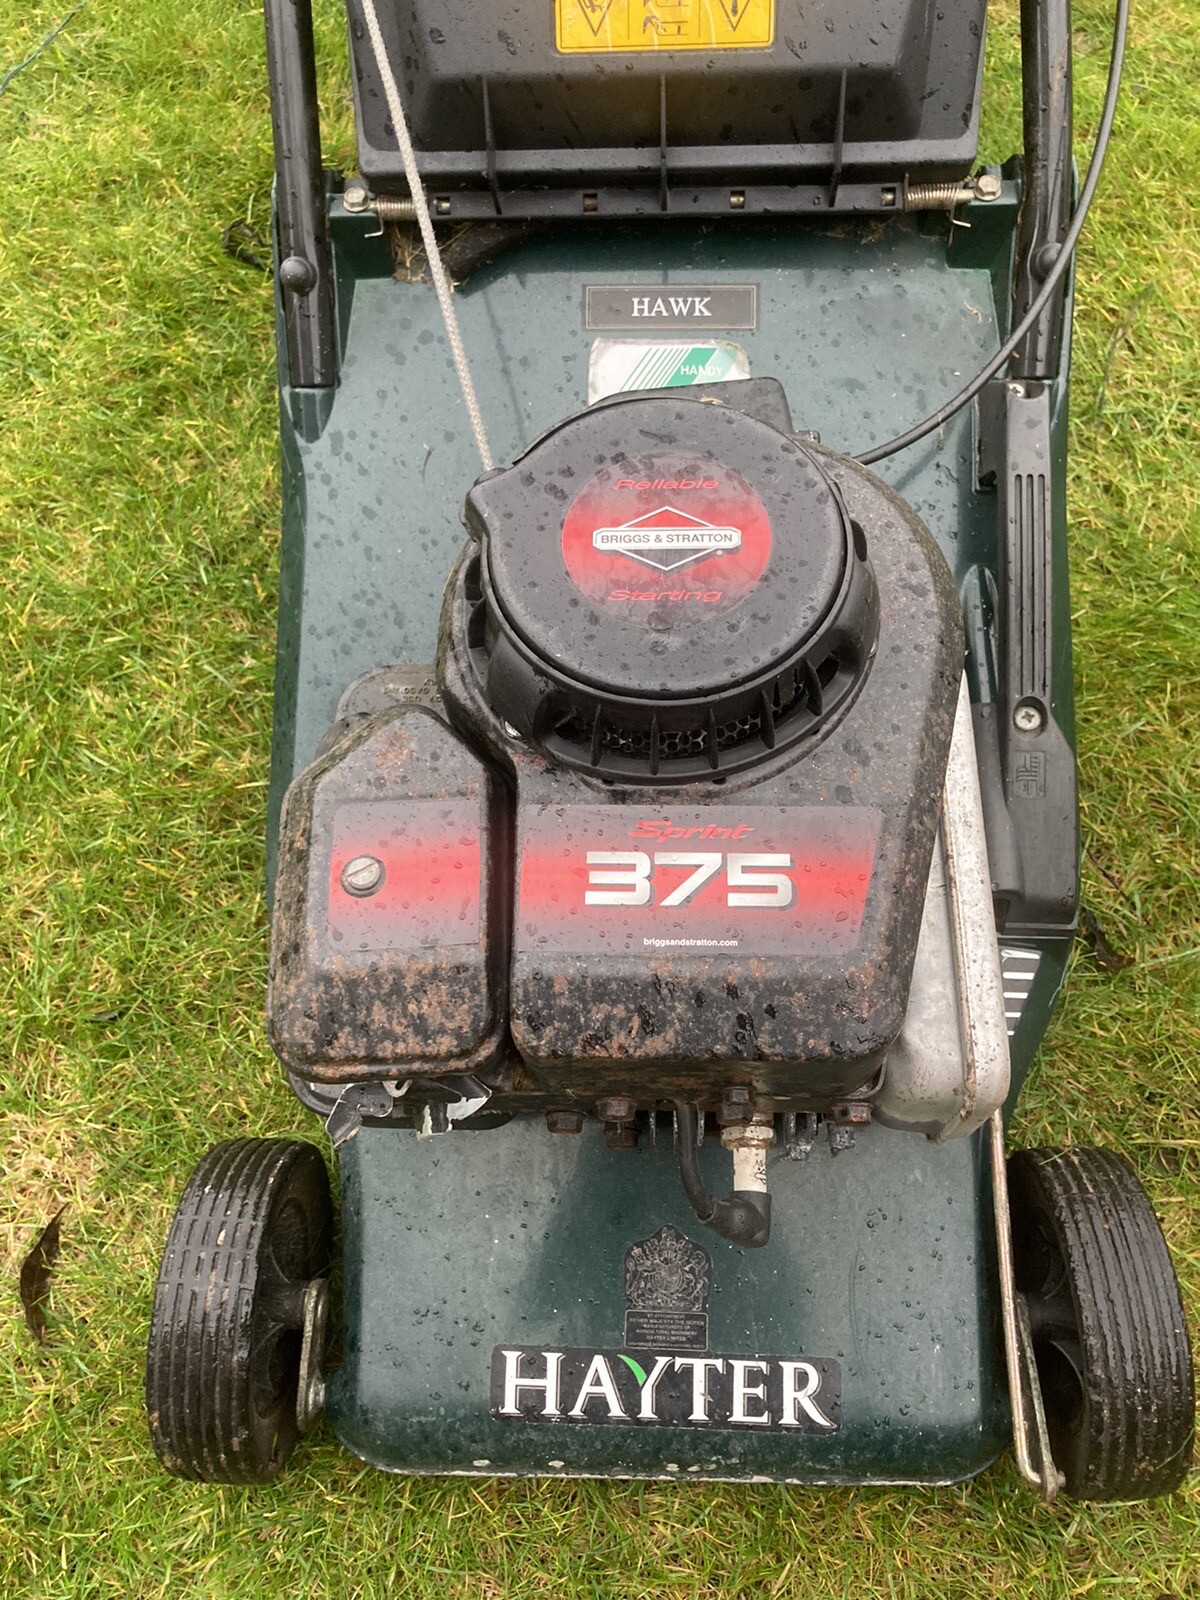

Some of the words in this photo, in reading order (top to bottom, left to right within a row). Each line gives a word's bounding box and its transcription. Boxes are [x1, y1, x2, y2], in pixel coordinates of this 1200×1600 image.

[631, 297, 712, 317] HAWK
[680, 364, 724, 377] HANDY
[614, 478, 719, 490] Reliable
[601, 534, 650, 544] BRIGGS
[654, 534, 663, 544] &
[666, 533, 733, 544] STRATTON
[607, 589, 723, 602] Starting
[628, 820, 755, 843] Sprint
[584, 851, 796, 909] 375
[643, 937, 738, 947] briggsandstratton.com
[499, 1350, 837, 1428] HAYTER
